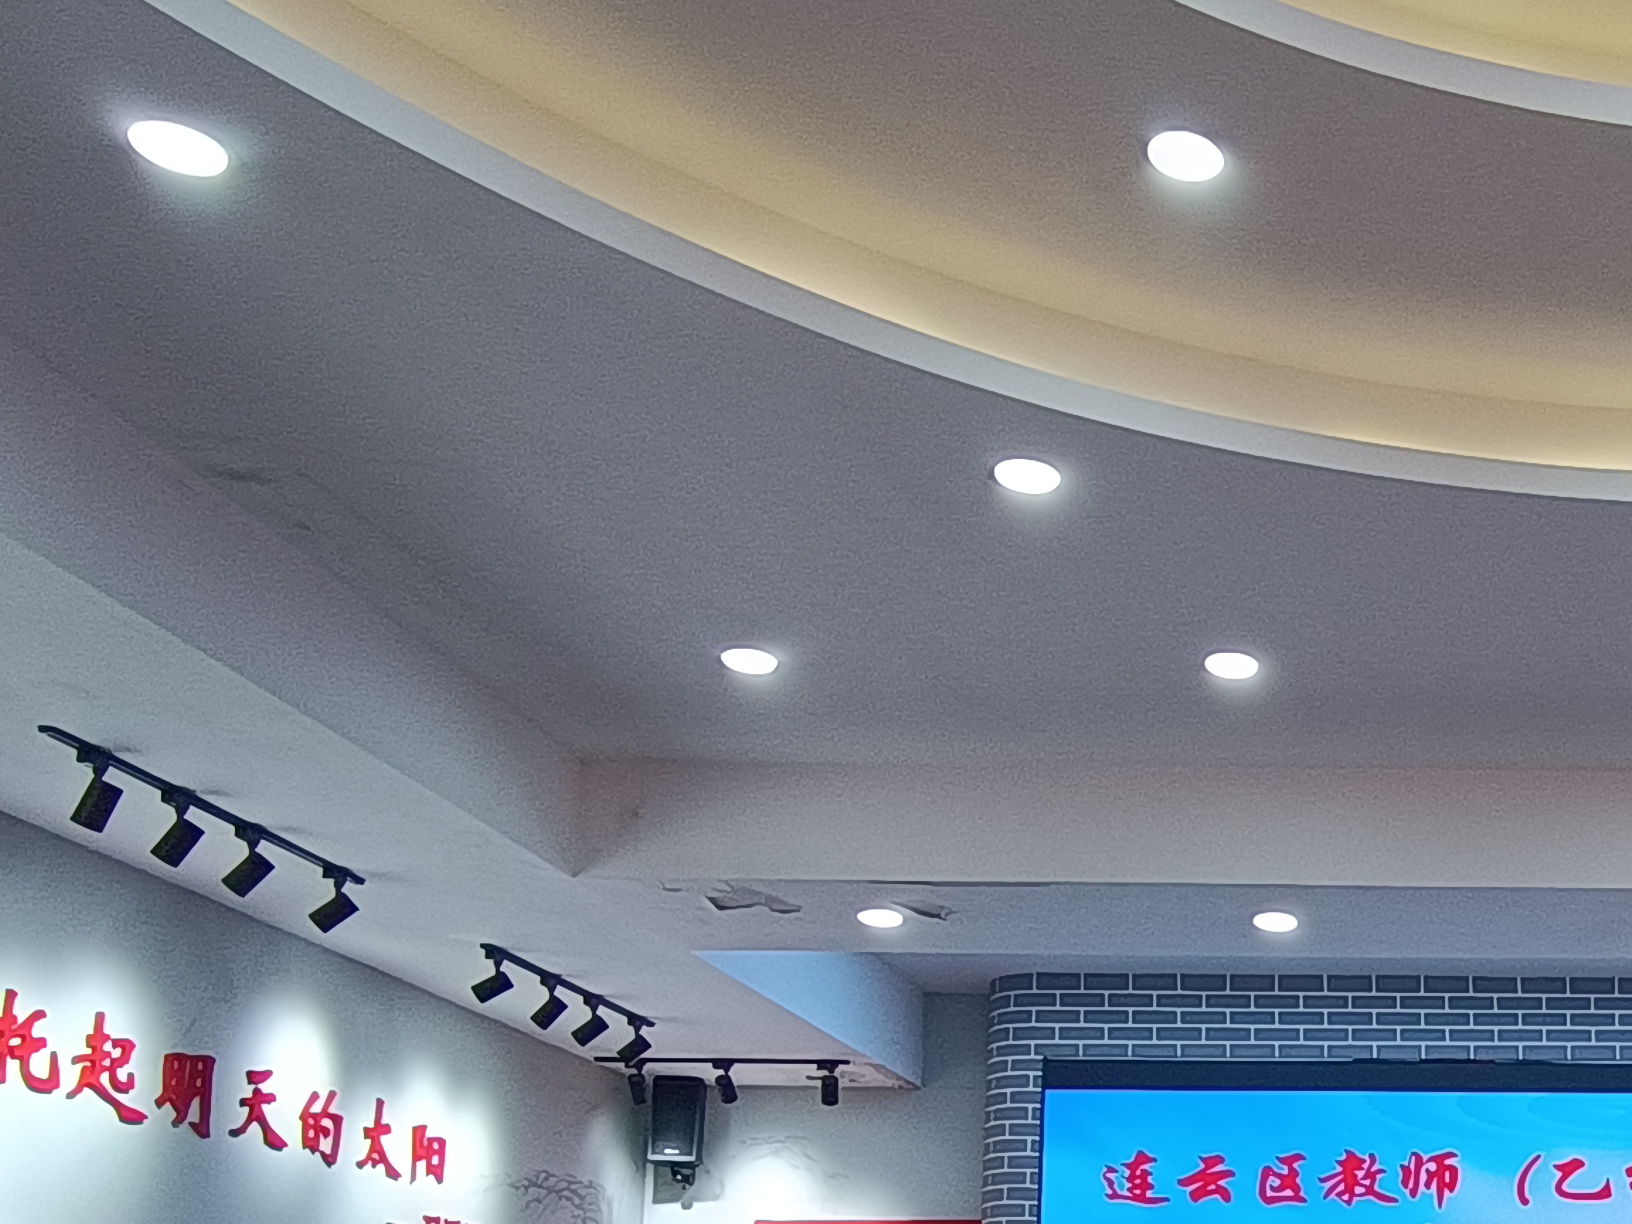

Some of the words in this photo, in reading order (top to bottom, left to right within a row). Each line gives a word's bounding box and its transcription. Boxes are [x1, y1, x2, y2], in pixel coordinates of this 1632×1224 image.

[0, 988, 447, 1184] 托起明天的太阳
